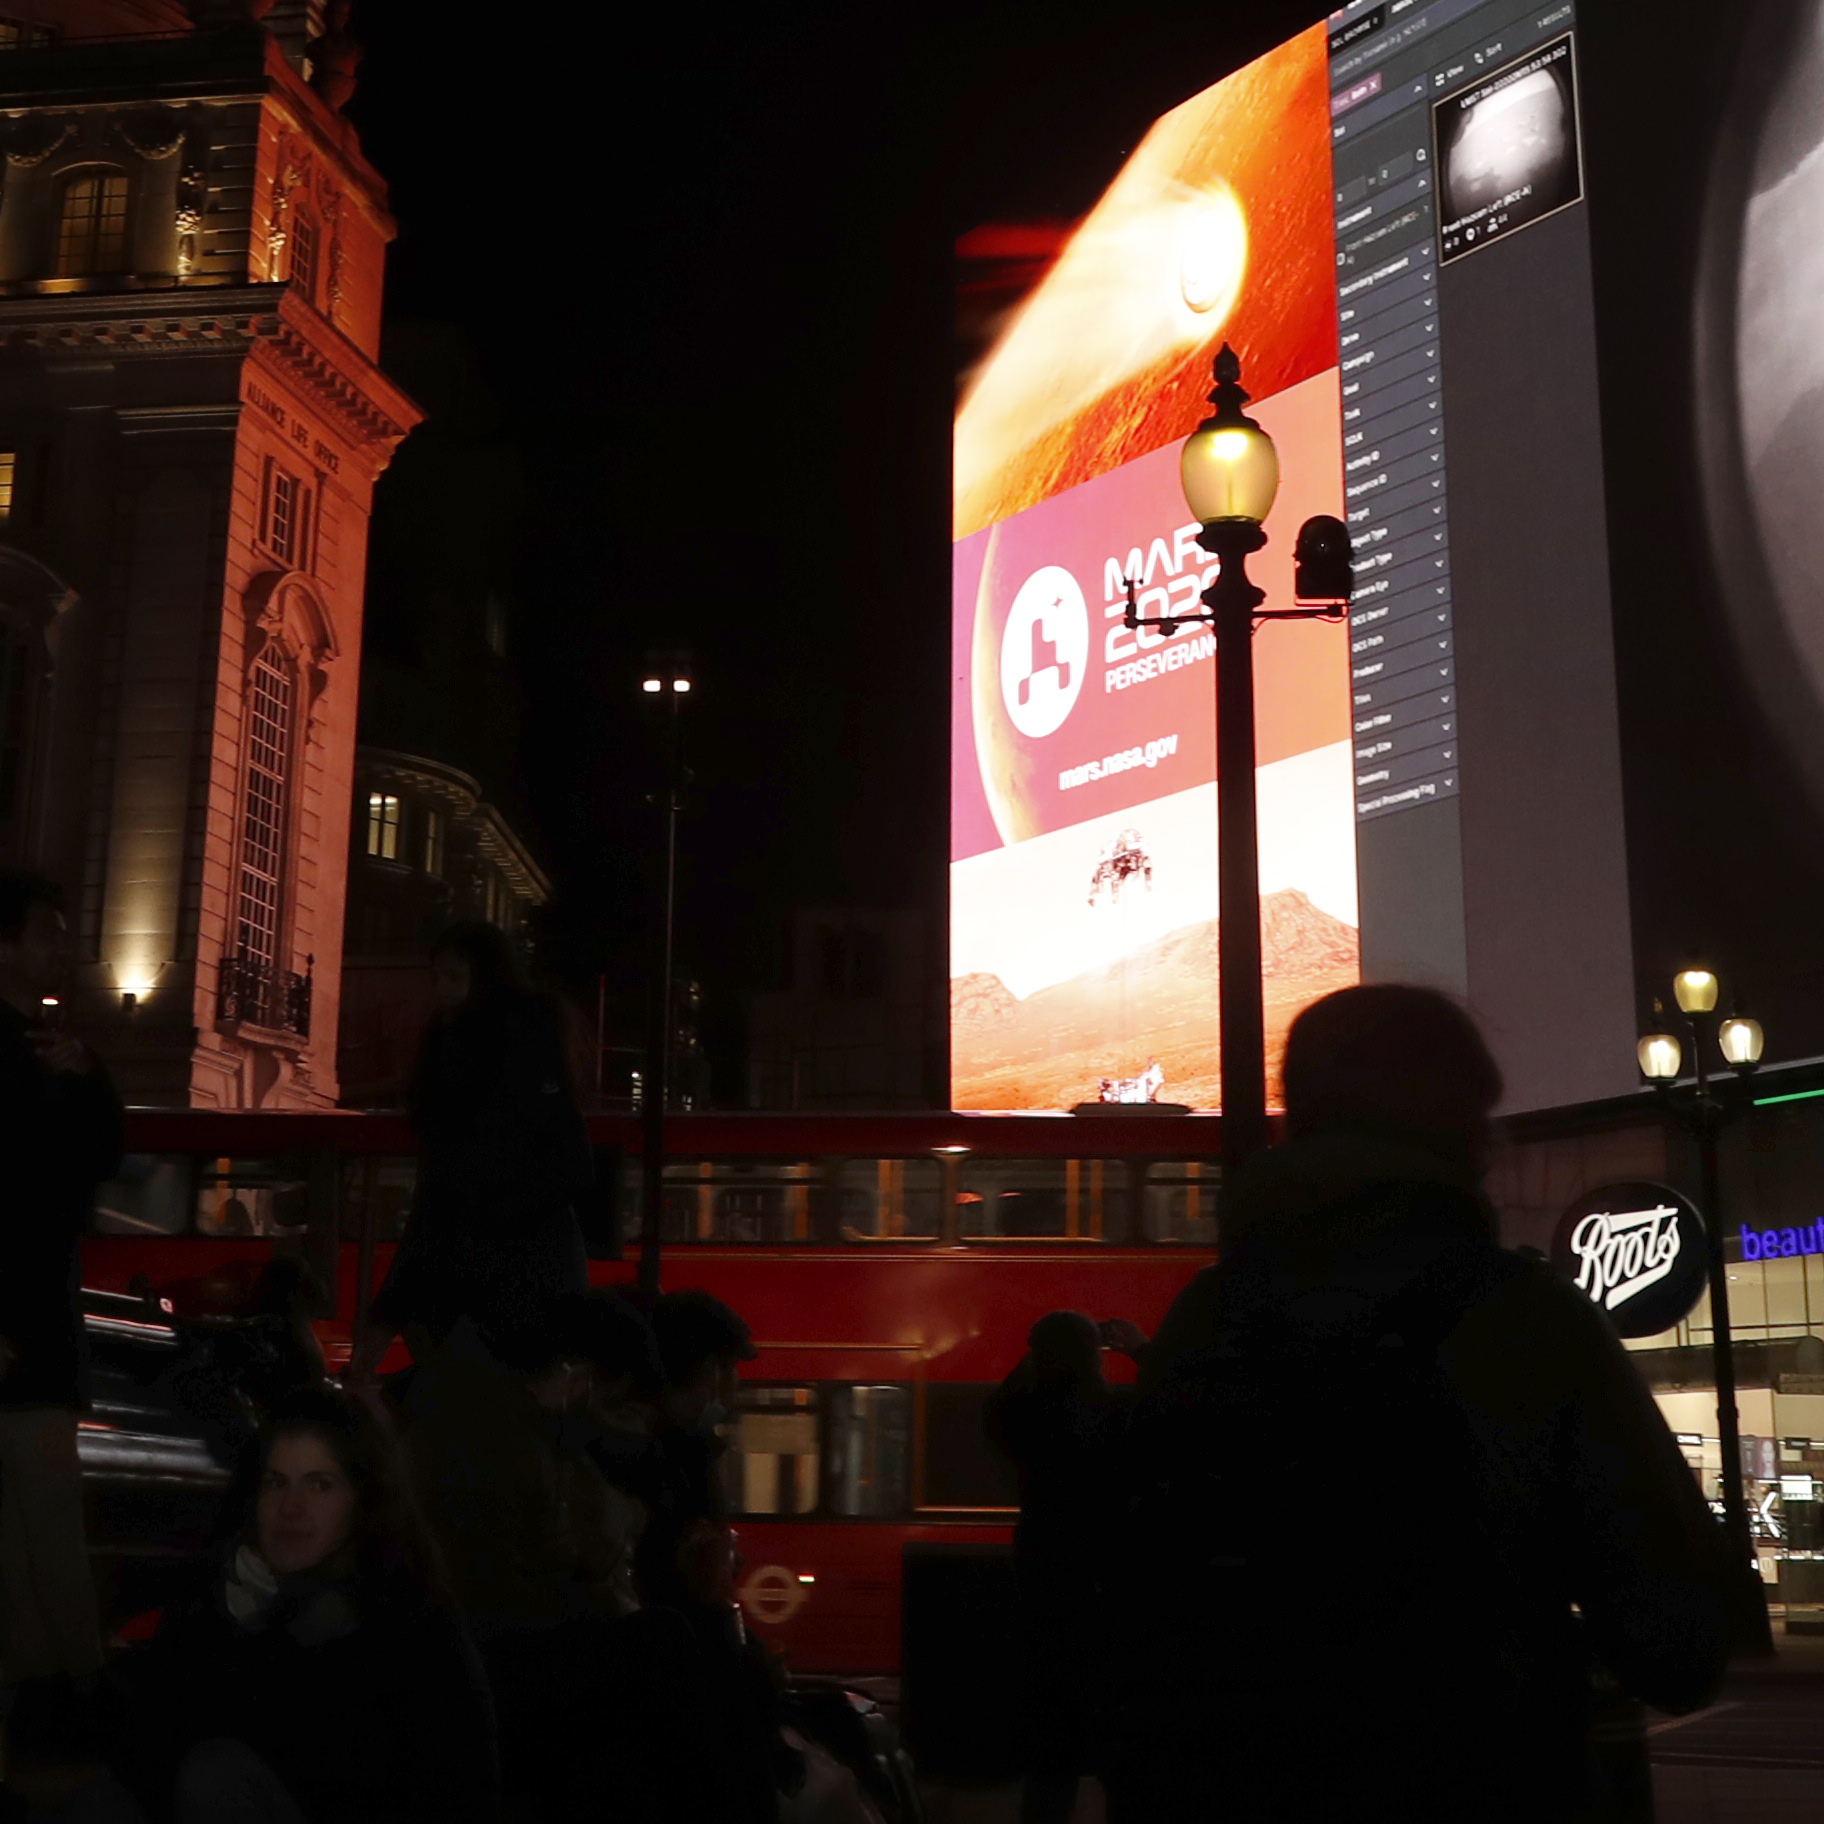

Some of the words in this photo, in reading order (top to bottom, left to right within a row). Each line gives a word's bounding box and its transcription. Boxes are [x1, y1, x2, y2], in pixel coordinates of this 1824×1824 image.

[1485, 43, 1503, 57] Sort
[1447, 65, 1464, 78] View
[1340, 275, 1374, 297] Secondary
[1374, 257, 1409, 279] Instrument
[1346, 455, 1371, 471] Activity
[1347, 478, 1378, 497] Sequence
[1348, 507, 1370, 522] Target
[1370, 527, 1388, 541] Type
[1104, 522, 1218, 601] MAR
[1375, 552, 1392, 565] Type
[1105, 633, 1217, 693] PERSEVERAN
[1059, 734, 1178, 790] mars.nasa.gov
[1382, 787, 1420, 805] Processing
[1571, 1205, 1681, 1311] Boots
